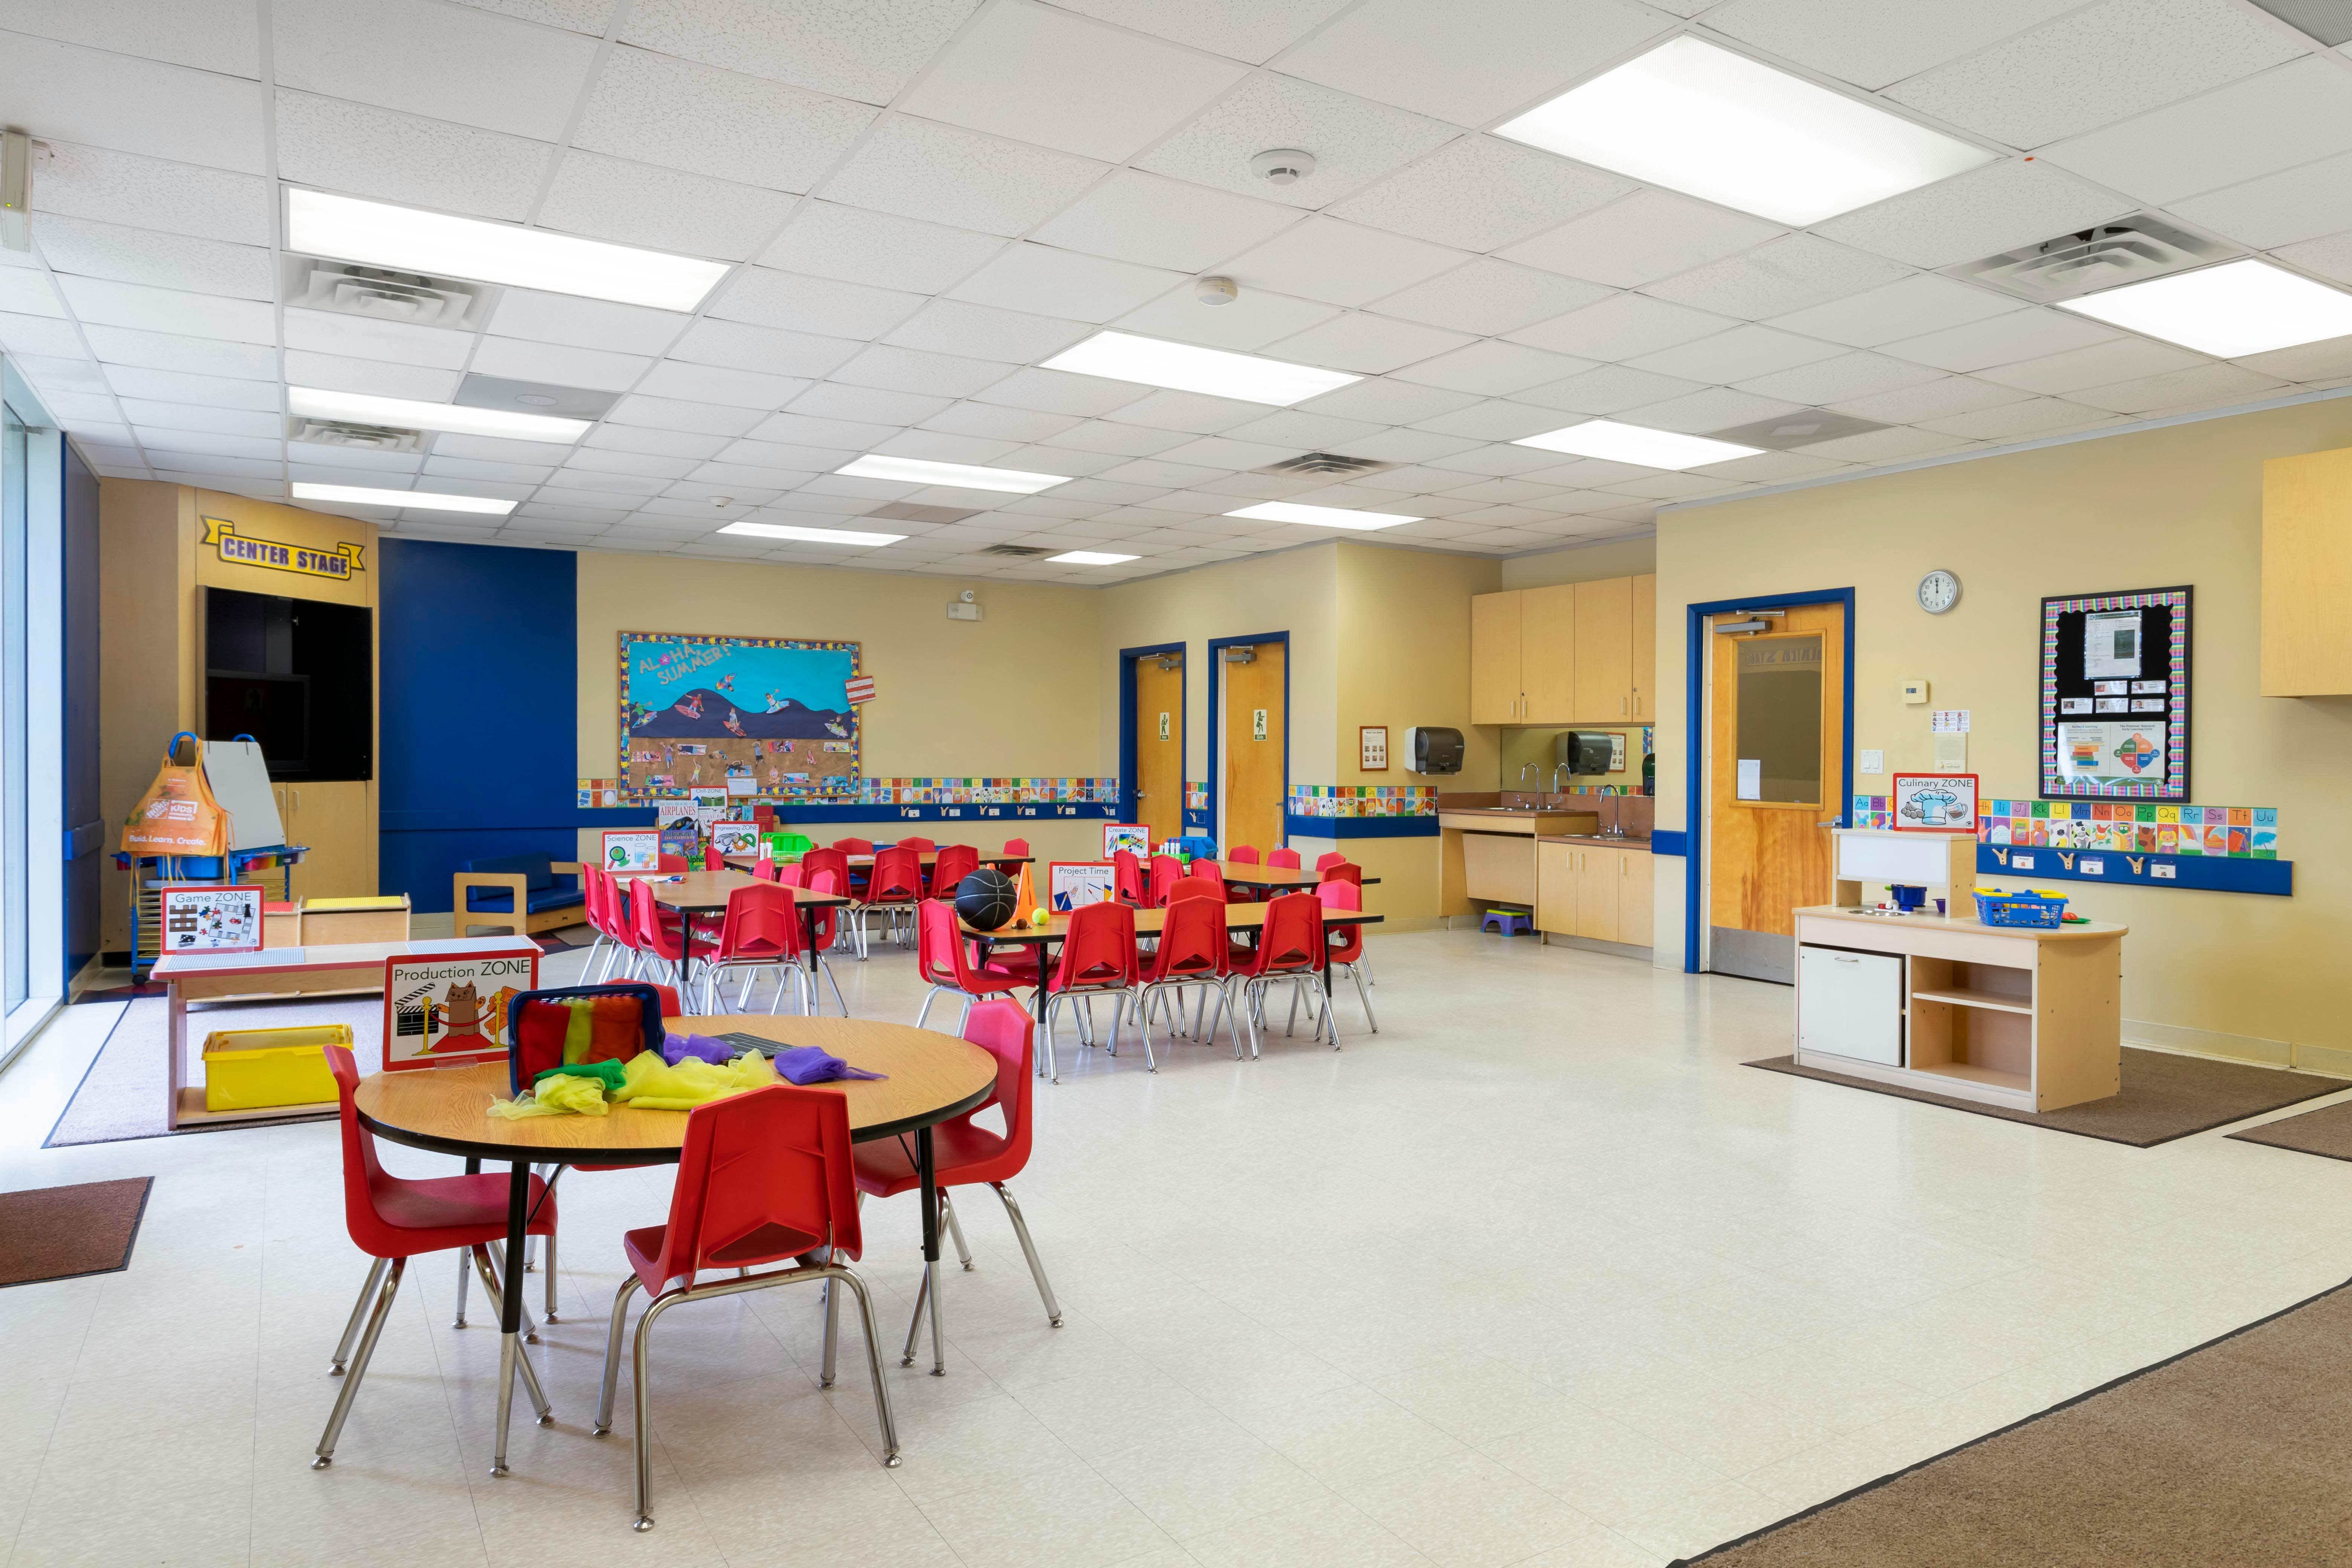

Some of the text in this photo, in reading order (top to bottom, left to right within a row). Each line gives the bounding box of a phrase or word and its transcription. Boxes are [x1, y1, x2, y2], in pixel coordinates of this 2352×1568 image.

[223, 538, 348, 576] CENTER STAGE
[639, 643, 701, 674] ALHA,
[1899, 779, 1972, 789] Culinary ZONE
[1367, 788, 1376, 797] Qq
[1855, 798, 1868, 807] Aa
[1873, 798, 1884, 807] Bb
[660, 806, 696, 816] AIRPLANES
[1998, 802, 2005, 812] Ii
[2015, 803, 2027, 817] Jj
[2034, 804, 2046, 813] Kk
[2072, 805, 2090, 815] Mm
[2095, 805, 2110, 816] Nn
[2115, 806, 2132, 817] Oo
[2138, 807, 2153, 821] Pp
[2158, 808, 2179, 823] Qq
[2184, 808, 2199, 819] Rr
[2208, 809, 2222, 820] Ss
[2232, 810, 2248, 821] Tt
[2256, 811, 2274, 822] Uu
[149, 835, 175, 843] Learn.
[177, 837, 206, 845] Create.
[175, 892, 252, 903] Game ZONE
[395, 959, 530, 981] Production ZONE
